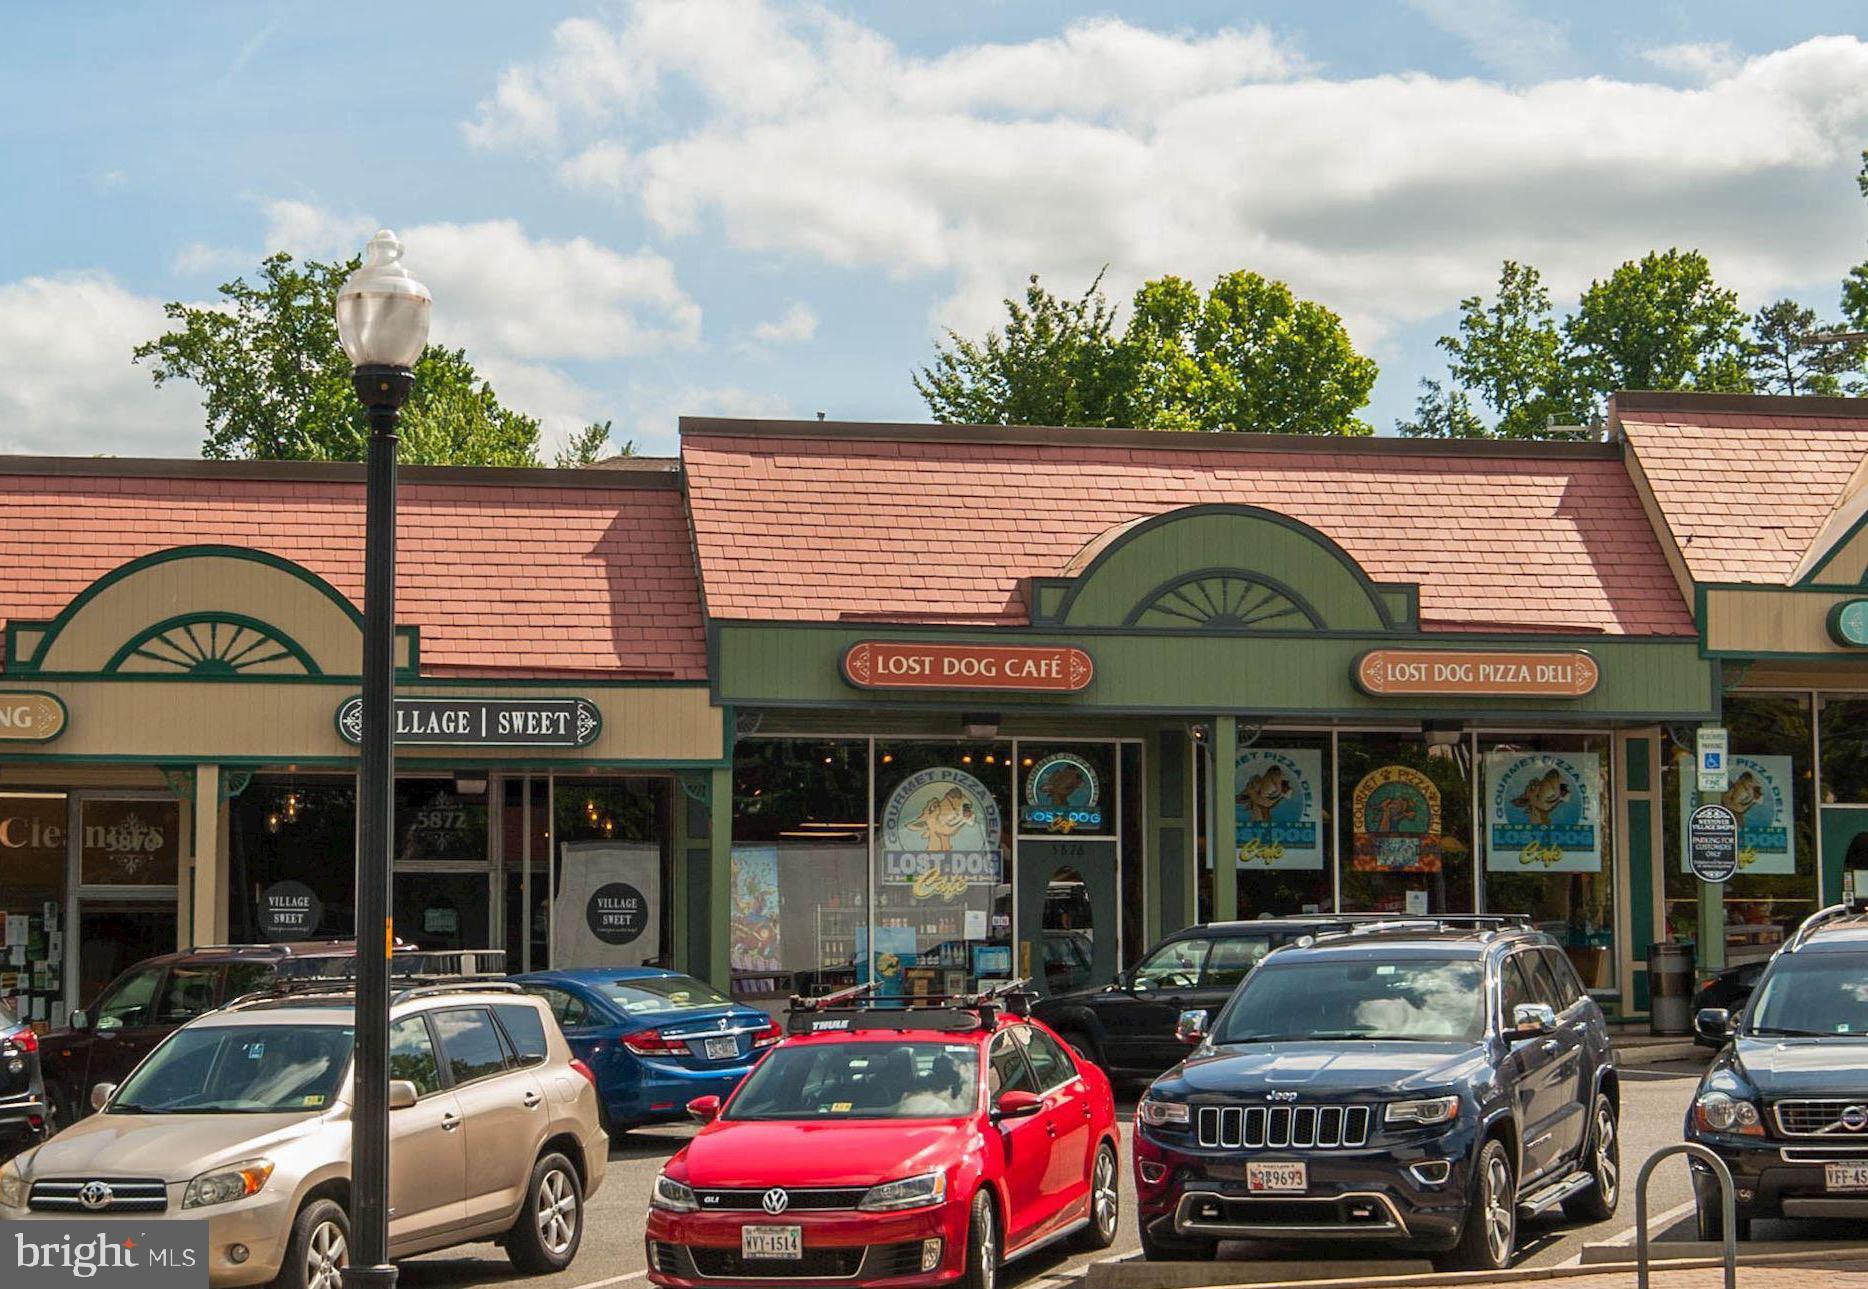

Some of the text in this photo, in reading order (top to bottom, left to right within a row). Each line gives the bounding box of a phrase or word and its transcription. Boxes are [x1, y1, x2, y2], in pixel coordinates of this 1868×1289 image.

[877, 655, 1063, 678] LOST DOG CAFÉ
[1387, 663, 1572, 683] LOST DOG PIZZA DELI
[396, 710, 571, 735] LLAGE SWEET
[1263, 751, 1312, 818] PIZZA DELI
[1495, 755, 1590, 821] GOURMET PIZZA DELI
[1735, 757, 1784, 824] PIZZA DELI
[886, 769, 935, 845] GOURMET
[941, 769, 987, 800] PIZZA
[985, 803, 999, 846] DELI
[416, 811, 467, 829] 5872
[1068, 811, 1102, 824] DOG
[1270, 828, 1314, 842] DOG
[1493, 831, 1594, 846] LOST DOG
[1744, 832, 1787, 848] DOG
[886, 852, 1000, 876] LOST DOG
[268, 896, 311, 908] VILLAGE
[597, 897, 638, 909] VILLAGE
[273, 913, 304, 924] SWEET
[602, 914, 632, 926] SWEET
[812, 1019, 850, 1031] THULE
[1266, 1089, 1298, 1102] Jeep
